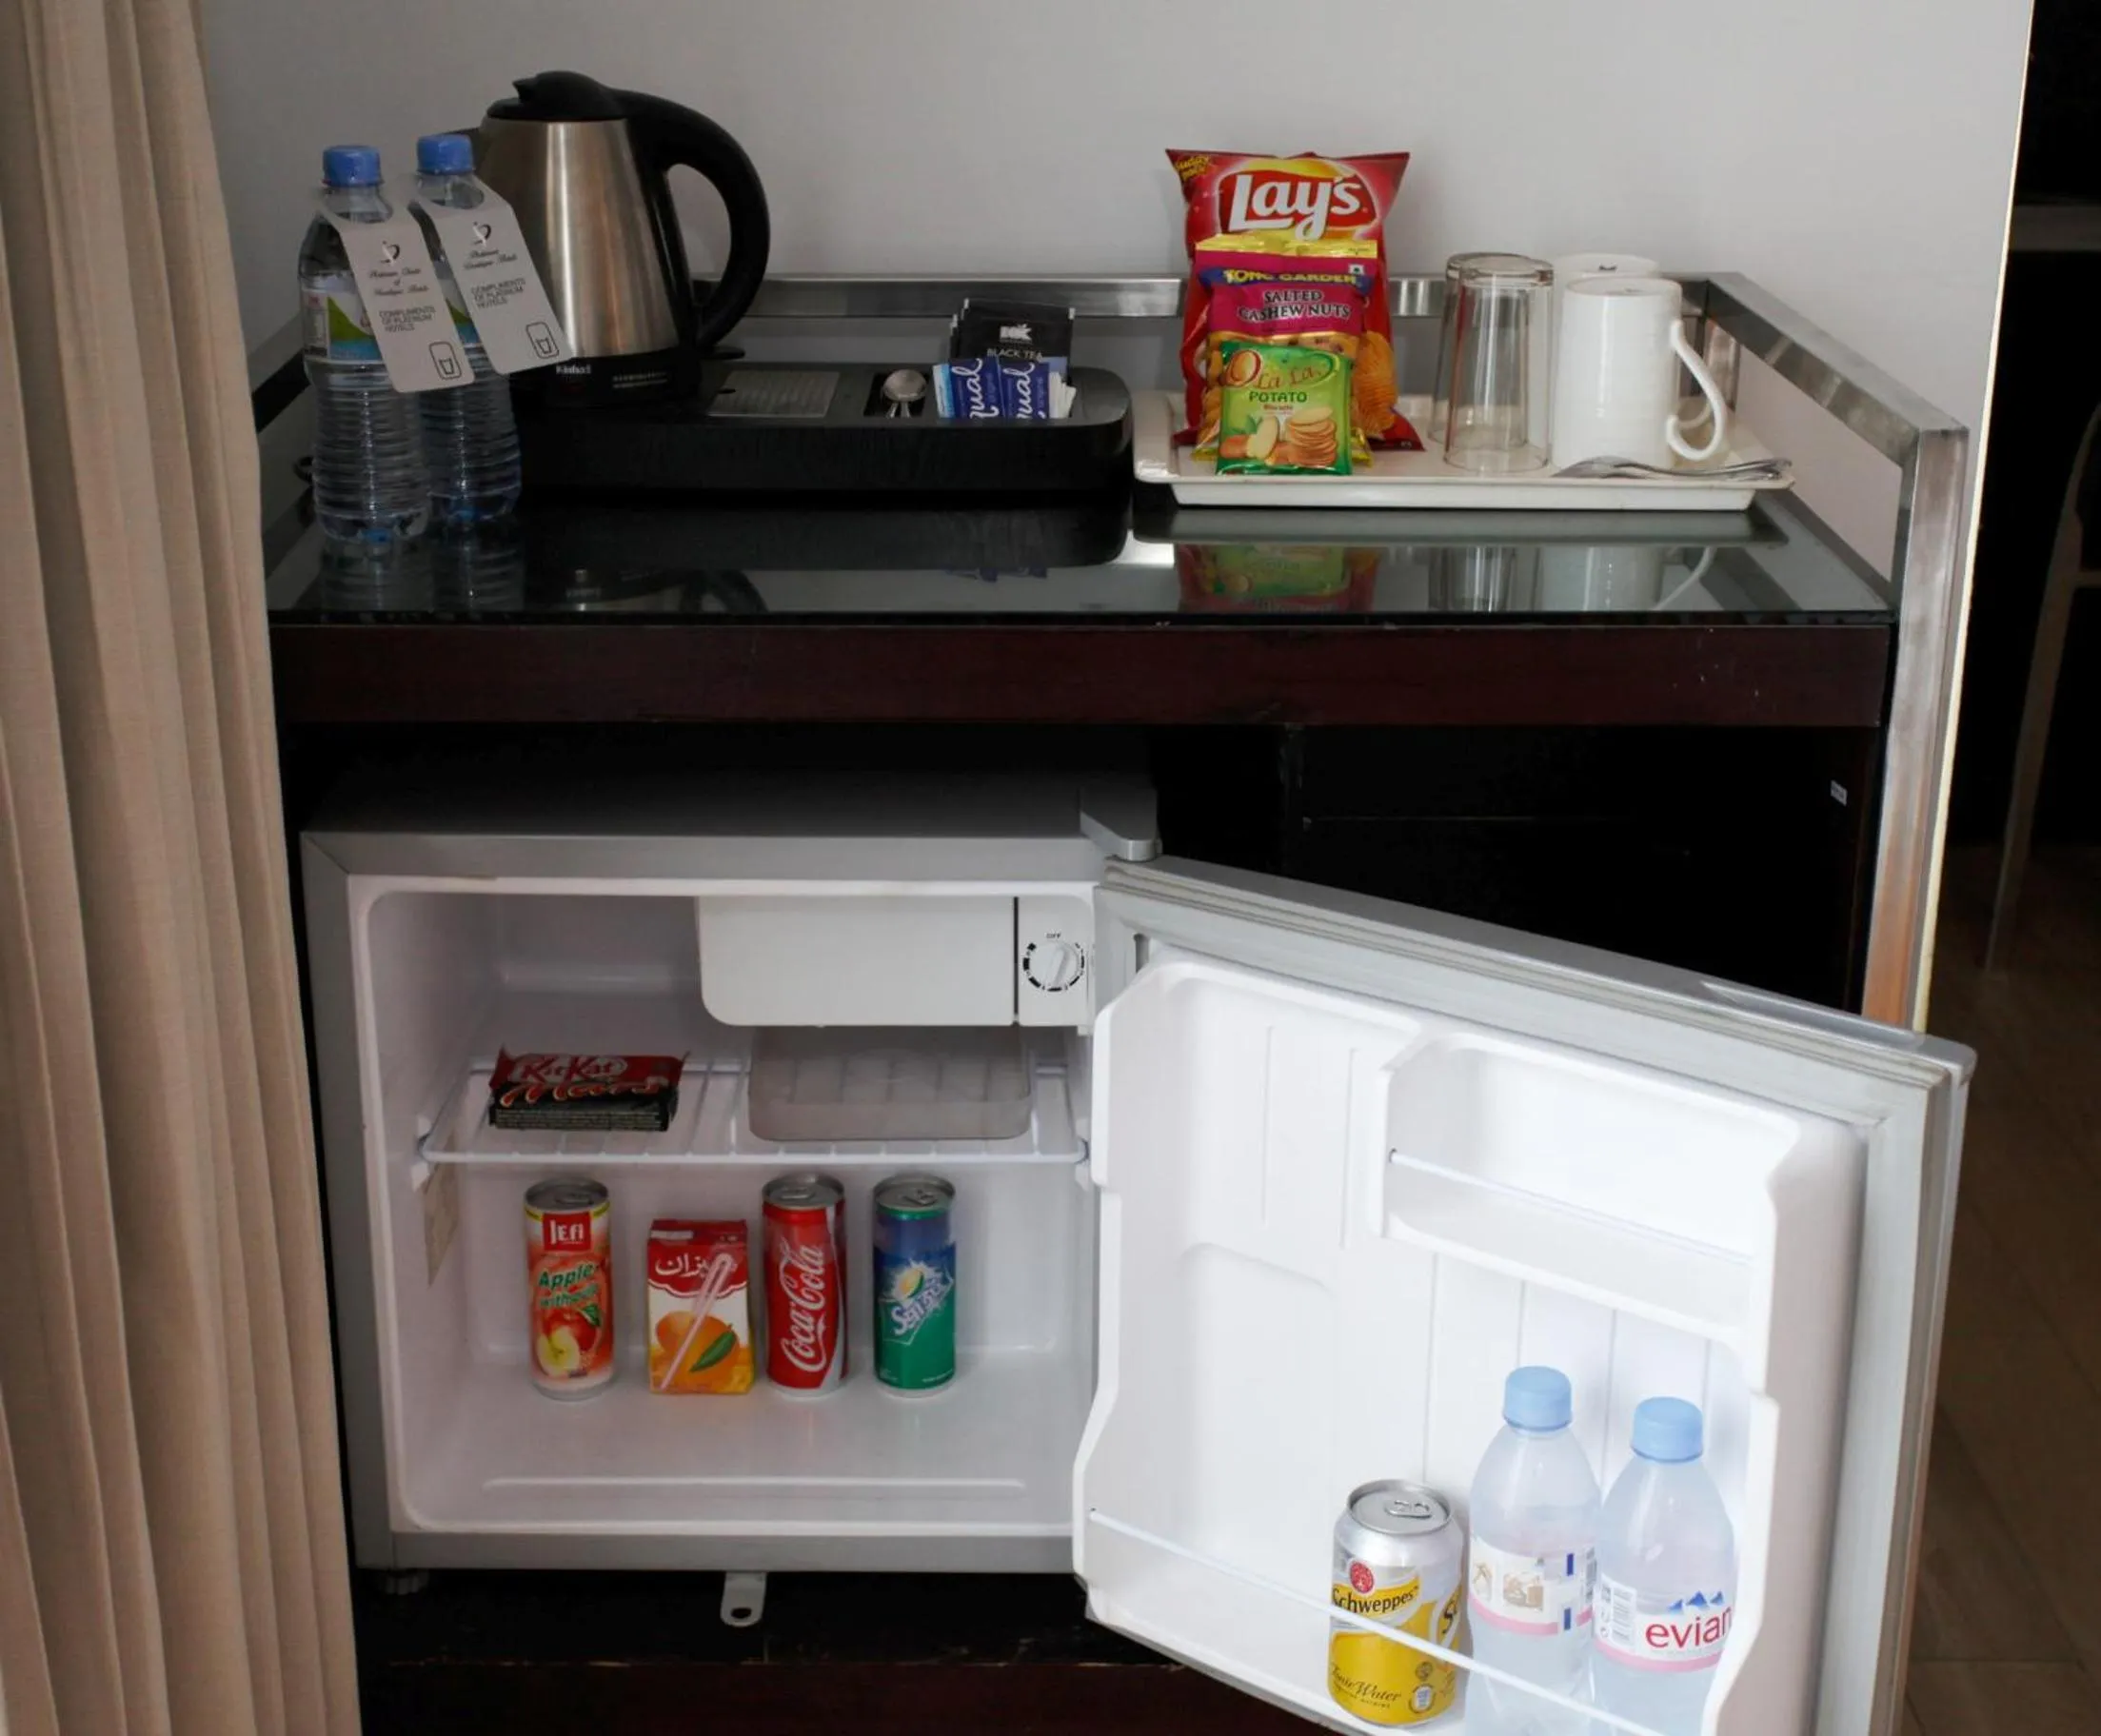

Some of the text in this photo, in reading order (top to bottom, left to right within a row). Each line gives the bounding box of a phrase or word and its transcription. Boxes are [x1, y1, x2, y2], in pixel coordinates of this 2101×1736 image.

[1228, 174, 1361, 241] Lay's
[1278, 272, 1357, 285] GARDEN
[1264, 290, 1322, 304] SALTED
[1239, 305, 1351, 323] CASHEW NUTS
[986, 348, 1020, 358] BLACK
[1249, 391, 1307, 404] POTATO
[539, 1263, 595, 1291] Apple
[1332, 1584, 1414, 1614] Schweppes
